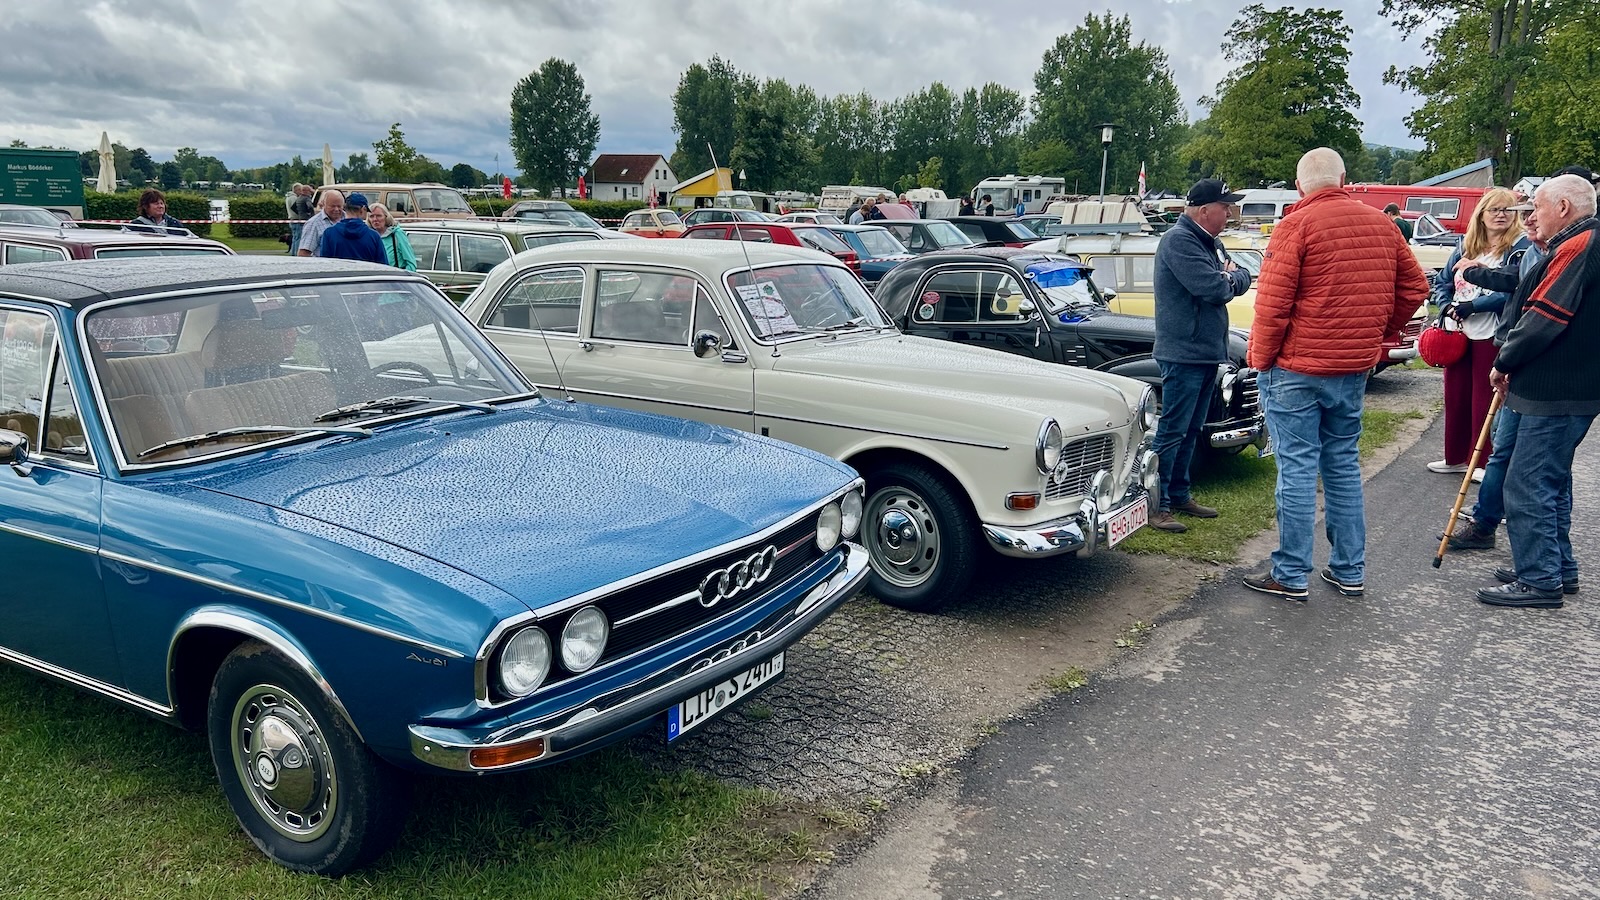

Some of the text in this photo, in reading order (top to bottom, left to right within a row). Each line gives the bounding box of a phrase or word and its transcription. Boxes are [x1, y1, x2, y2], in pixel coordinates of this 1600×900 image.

[405, 652, 447, 667] Audi
[683, 687, 715, 728] LIP
[729, 677, 739, 698] S
[670, 722, 677, 733] D
